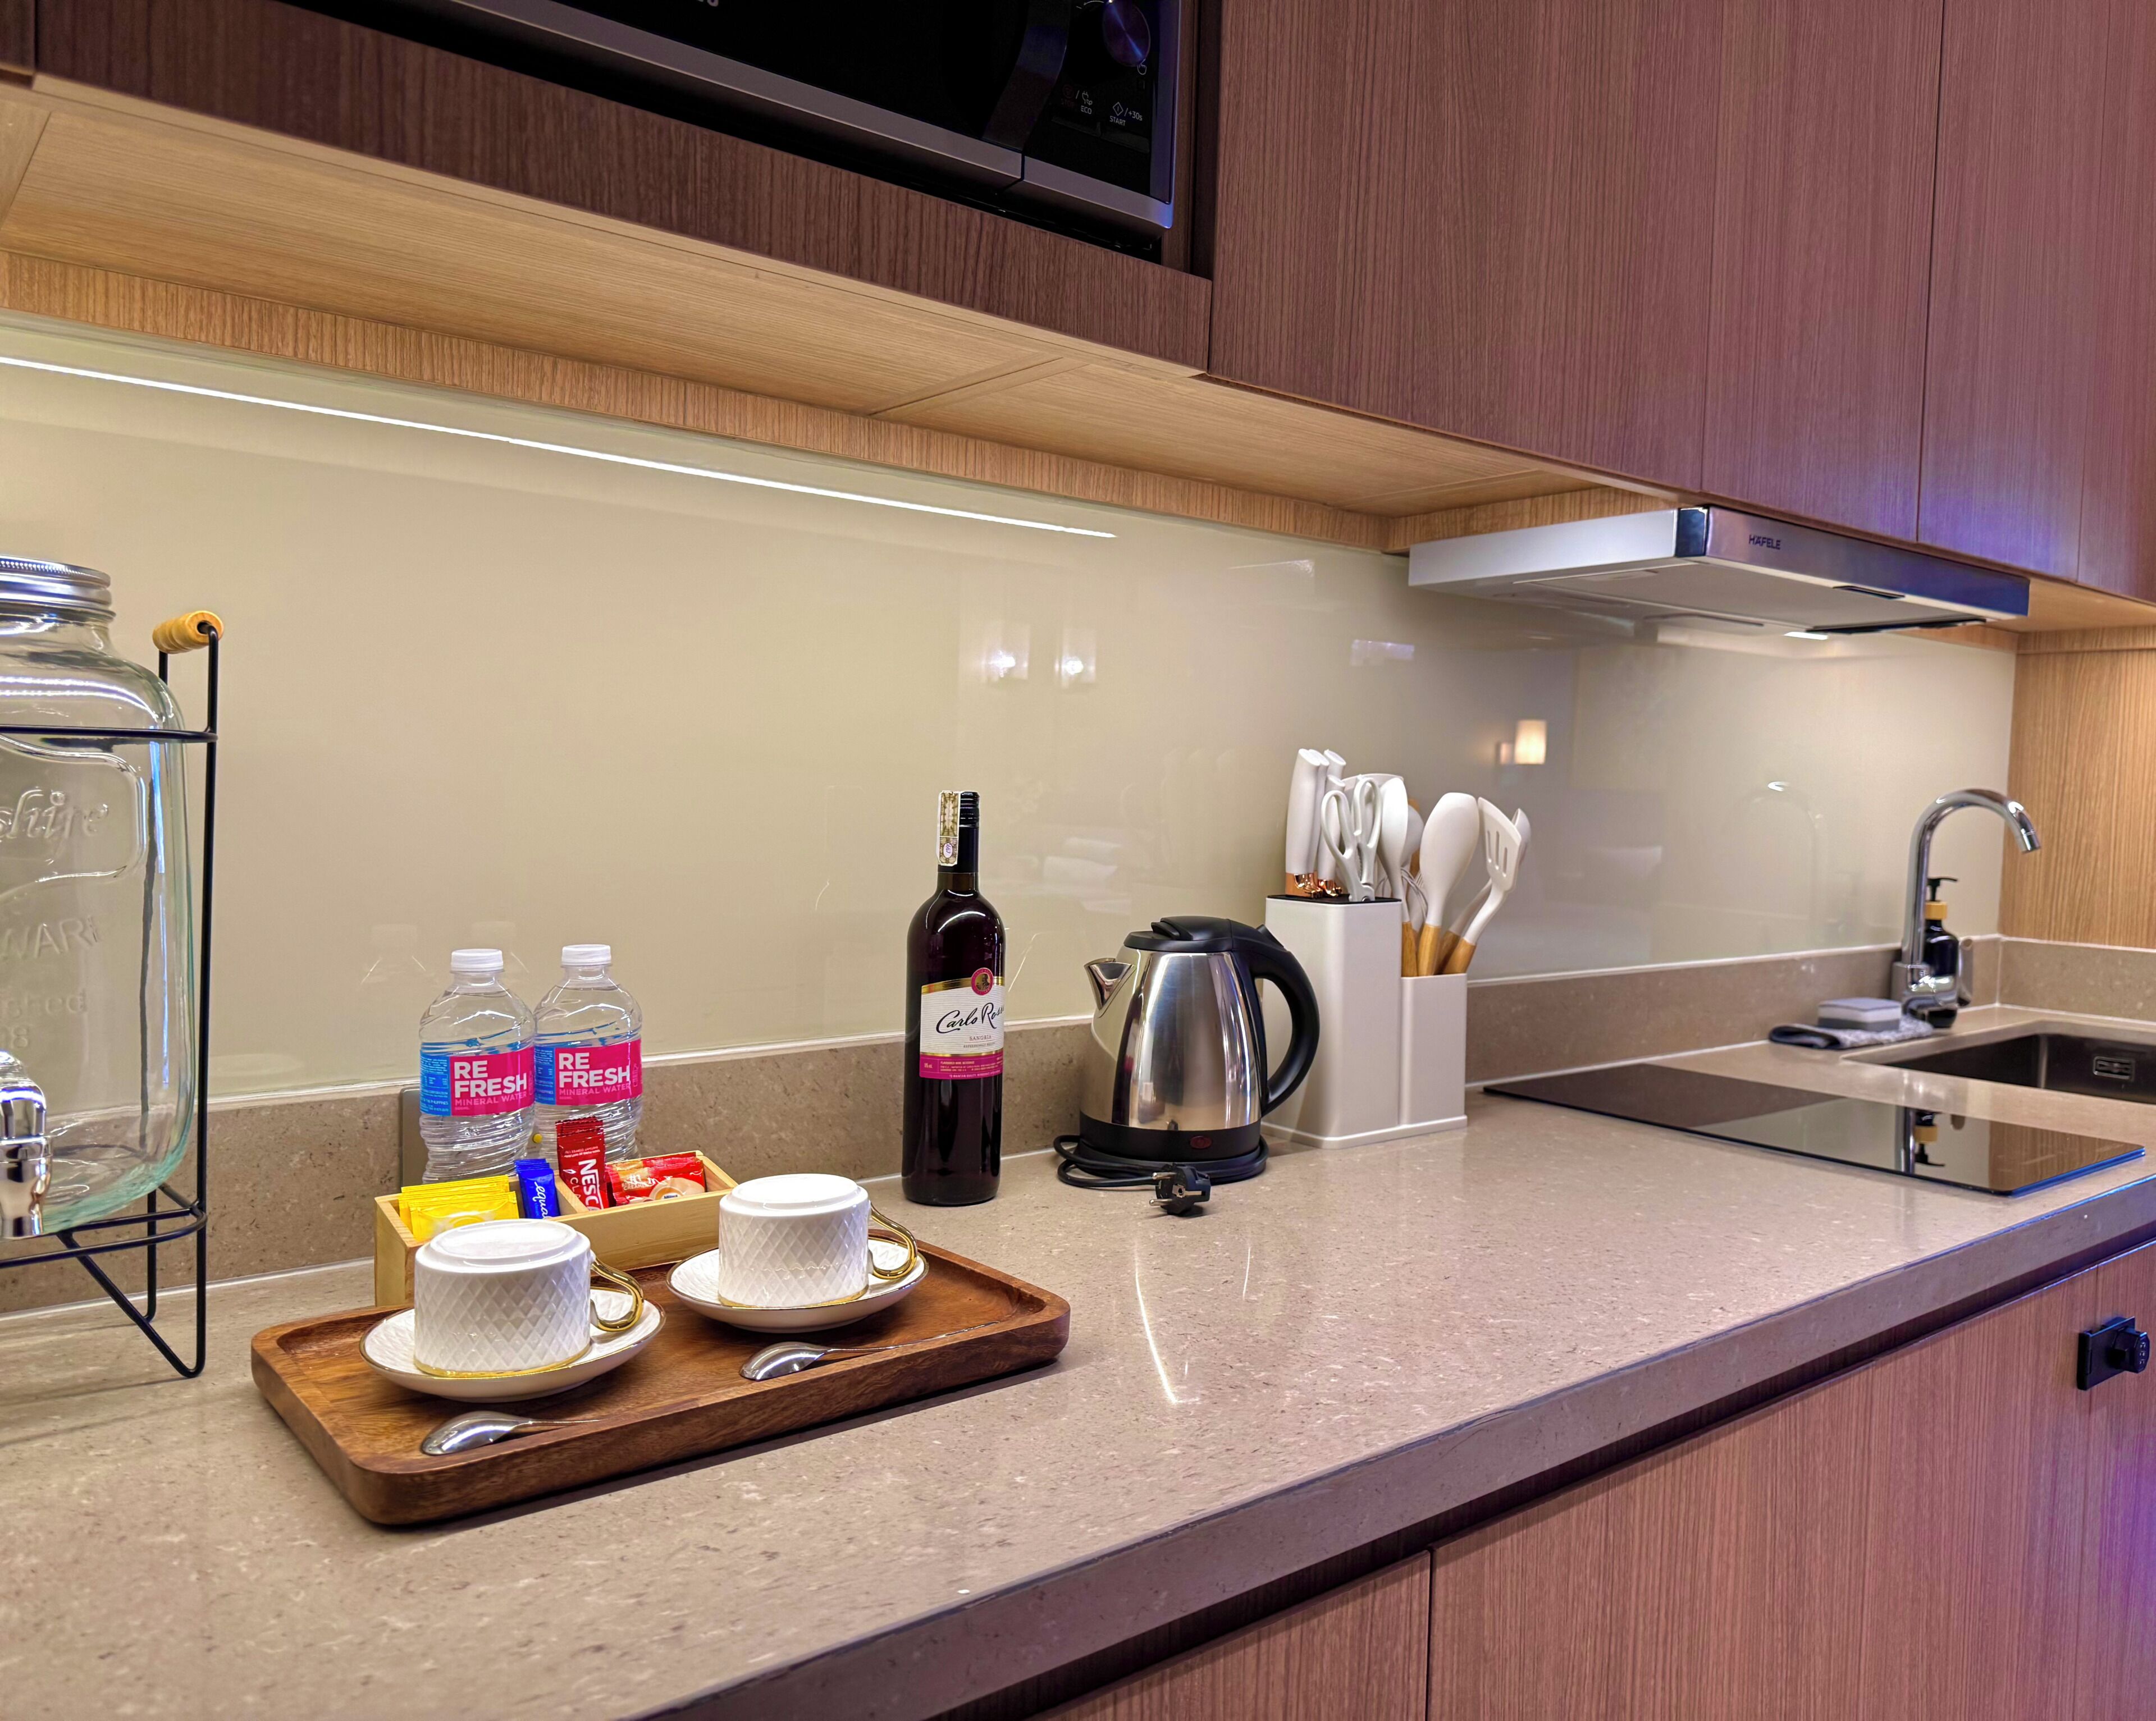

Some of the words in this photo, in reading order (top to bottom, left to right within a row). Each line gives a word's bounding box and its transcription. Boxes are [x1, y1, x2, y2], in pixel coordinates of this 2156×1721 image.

[1080, 105, 1093, 115] ECO
[1109, 116, 1126, 126] START
[936, 1008, 978, 1034] Carlo
[454, 1060, 488, 1079] RE
[559, 1052, 590, 1070] RE
[455, 1073, 527, 1098] FRESH
[559, 1065, 631, 1088] FRESH
[602, 1083, 631, 1093] WATER
[455, 1097, 499, 1106] MINERAL
[501, 1091, 527, 1102] WATER
[578, 1159, 604, 1211] NESC
